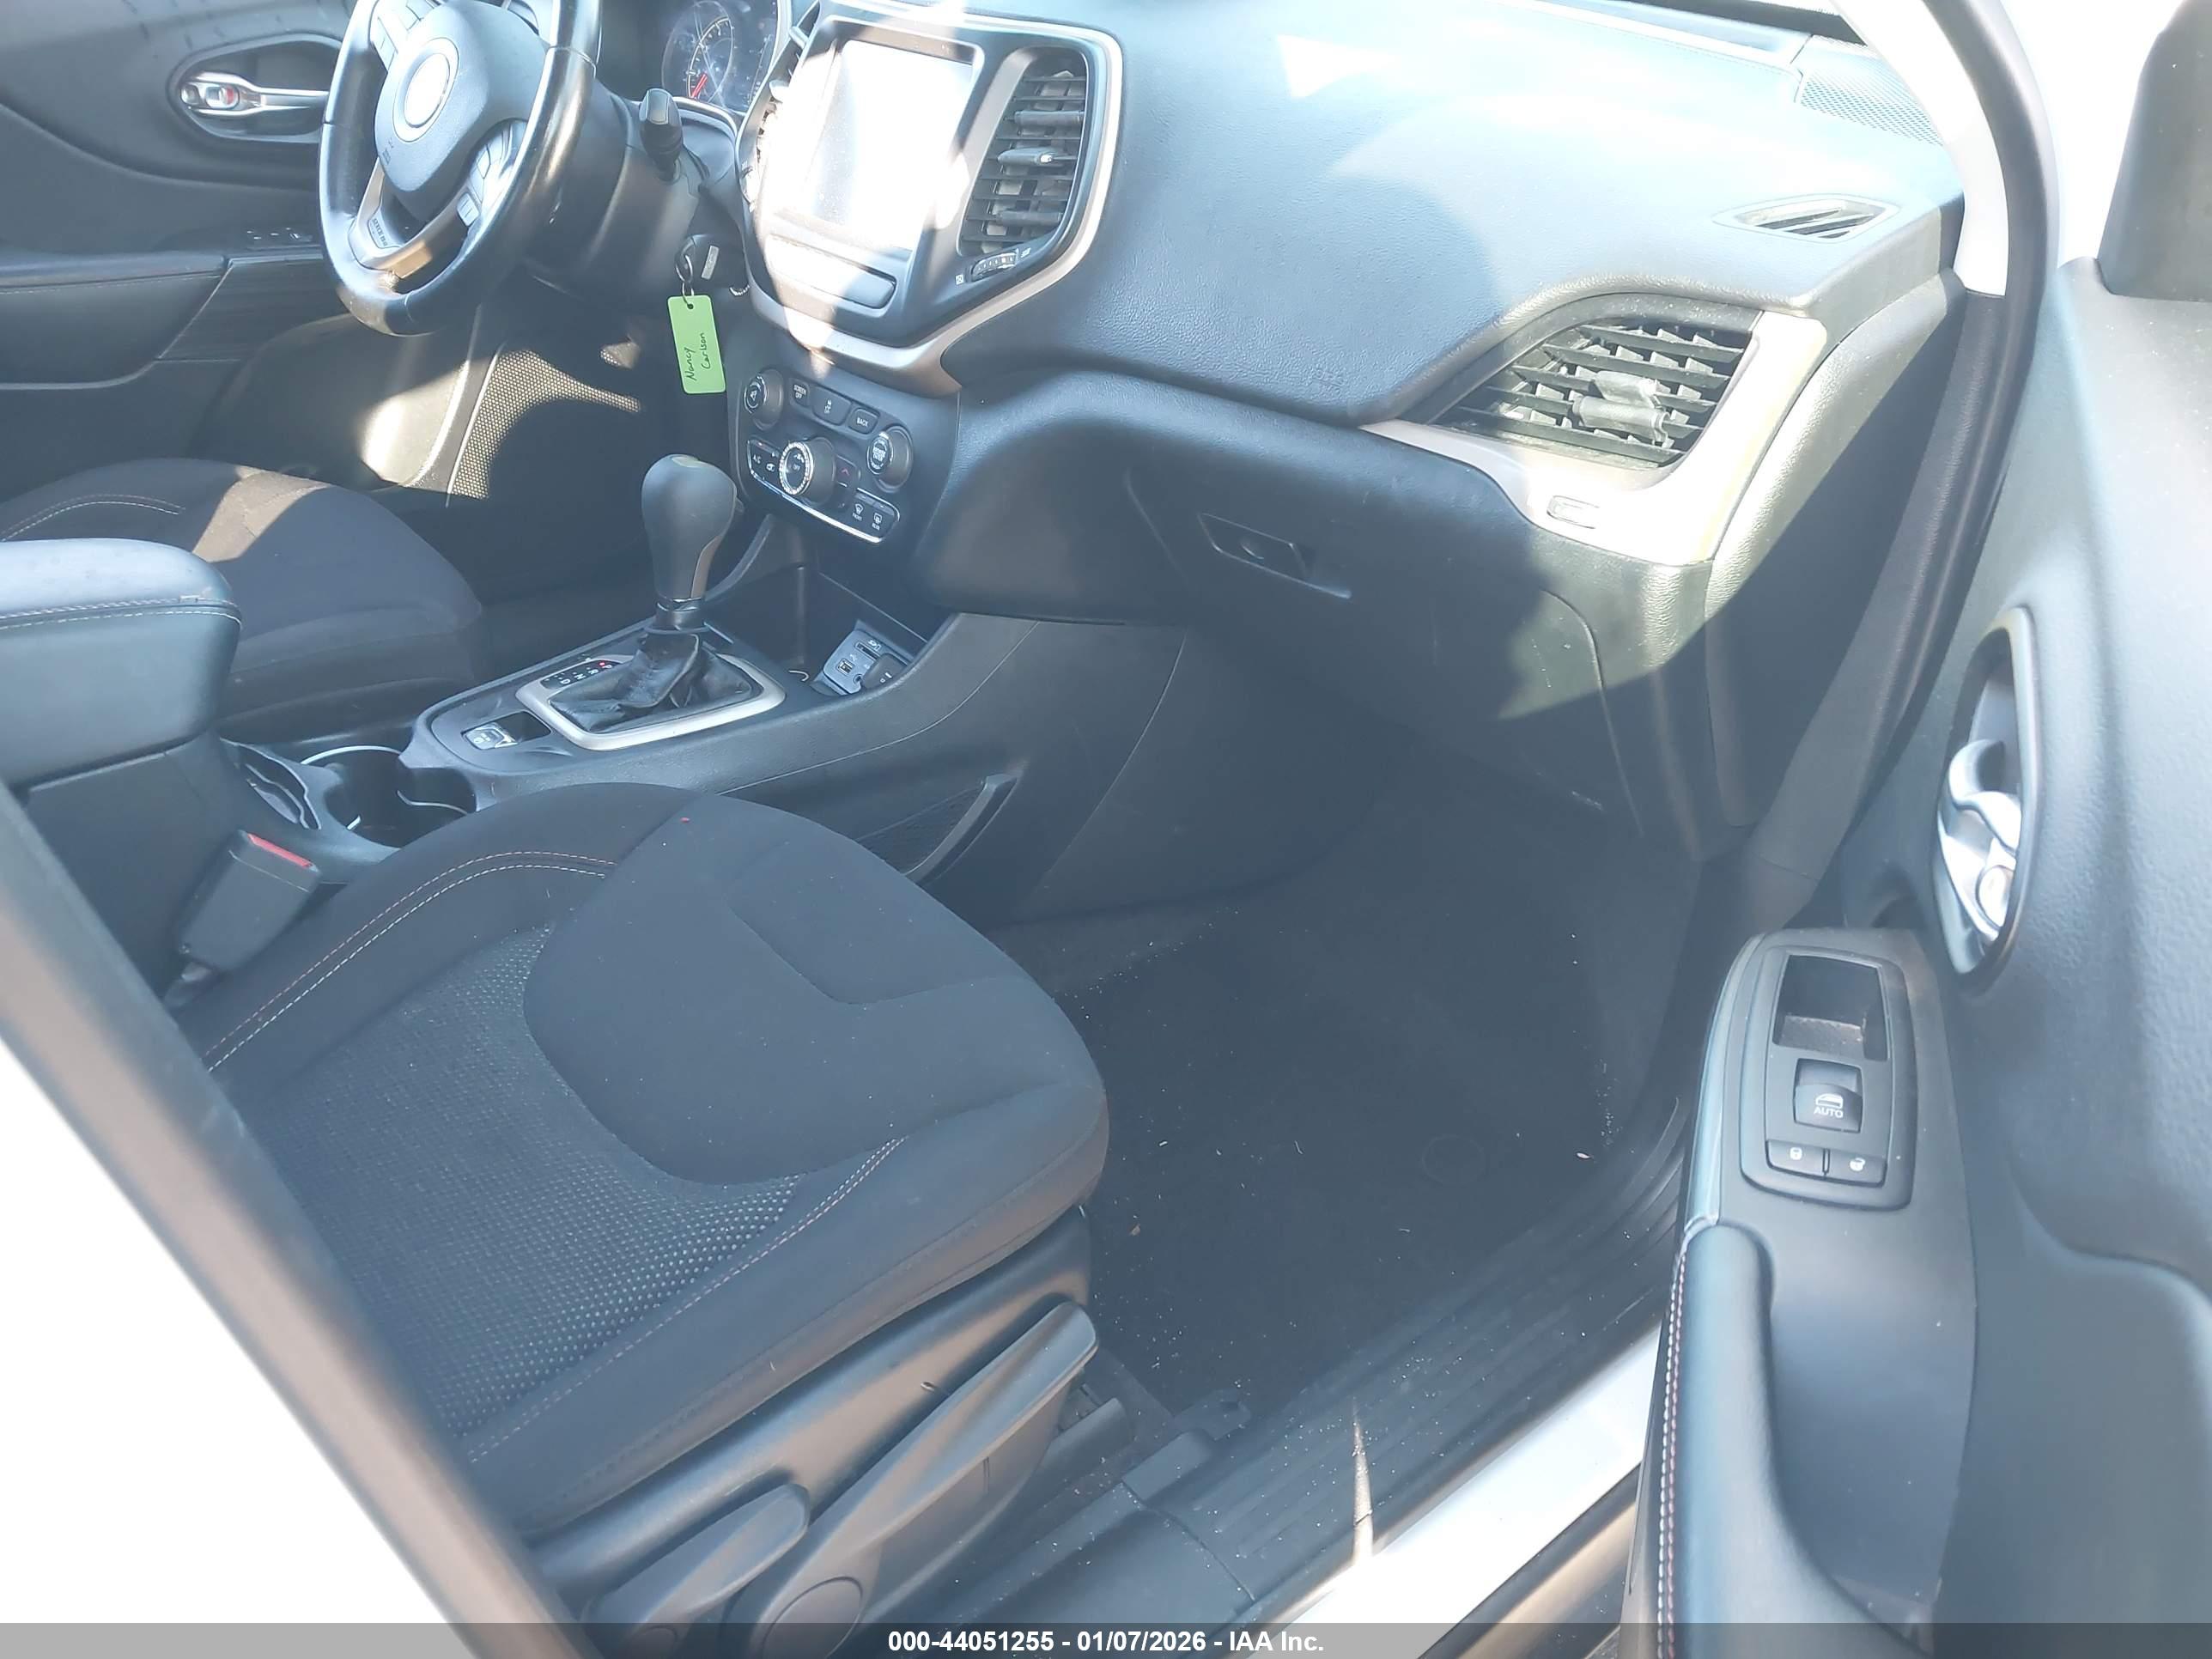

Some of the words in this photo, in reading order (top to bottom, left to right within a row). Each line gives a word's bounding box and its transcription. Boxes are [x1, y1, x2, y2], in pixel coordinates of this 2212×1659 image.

[699, 332, 711, 369] Carlson
[684, 347, 697, 381] Nancy
[857, 417, 868, 428] BACK
[1814, 1106, 1844, 1118] AUTO
